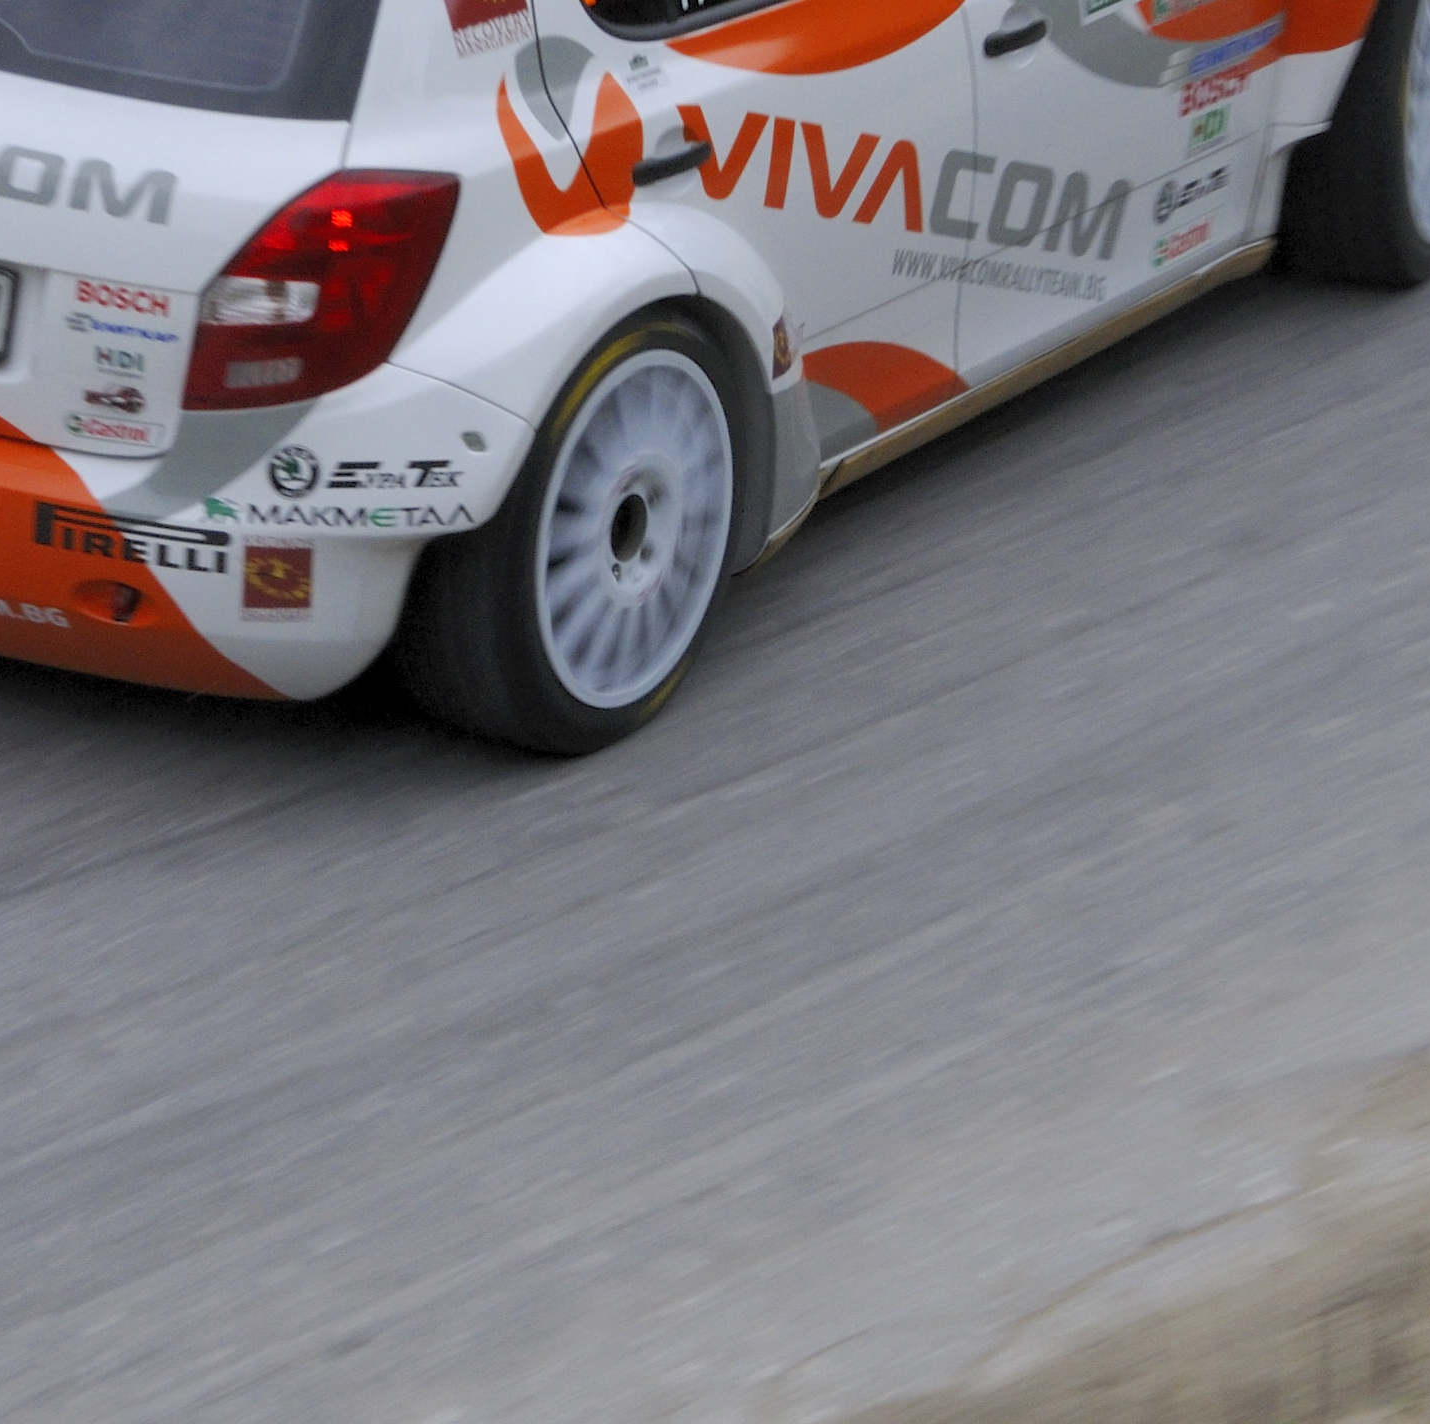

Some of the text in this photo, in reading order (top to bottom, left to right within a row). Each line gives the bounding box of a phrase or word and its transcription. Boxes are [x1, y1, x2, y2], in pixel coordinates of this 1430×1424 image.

[452, 9, 533, 49] RECOVERY
[677, 103, 1135, 263] VIVACOM
[76, 278, 171, 318] BOSCH
[33, 501, 231, 575] PIRELLI
